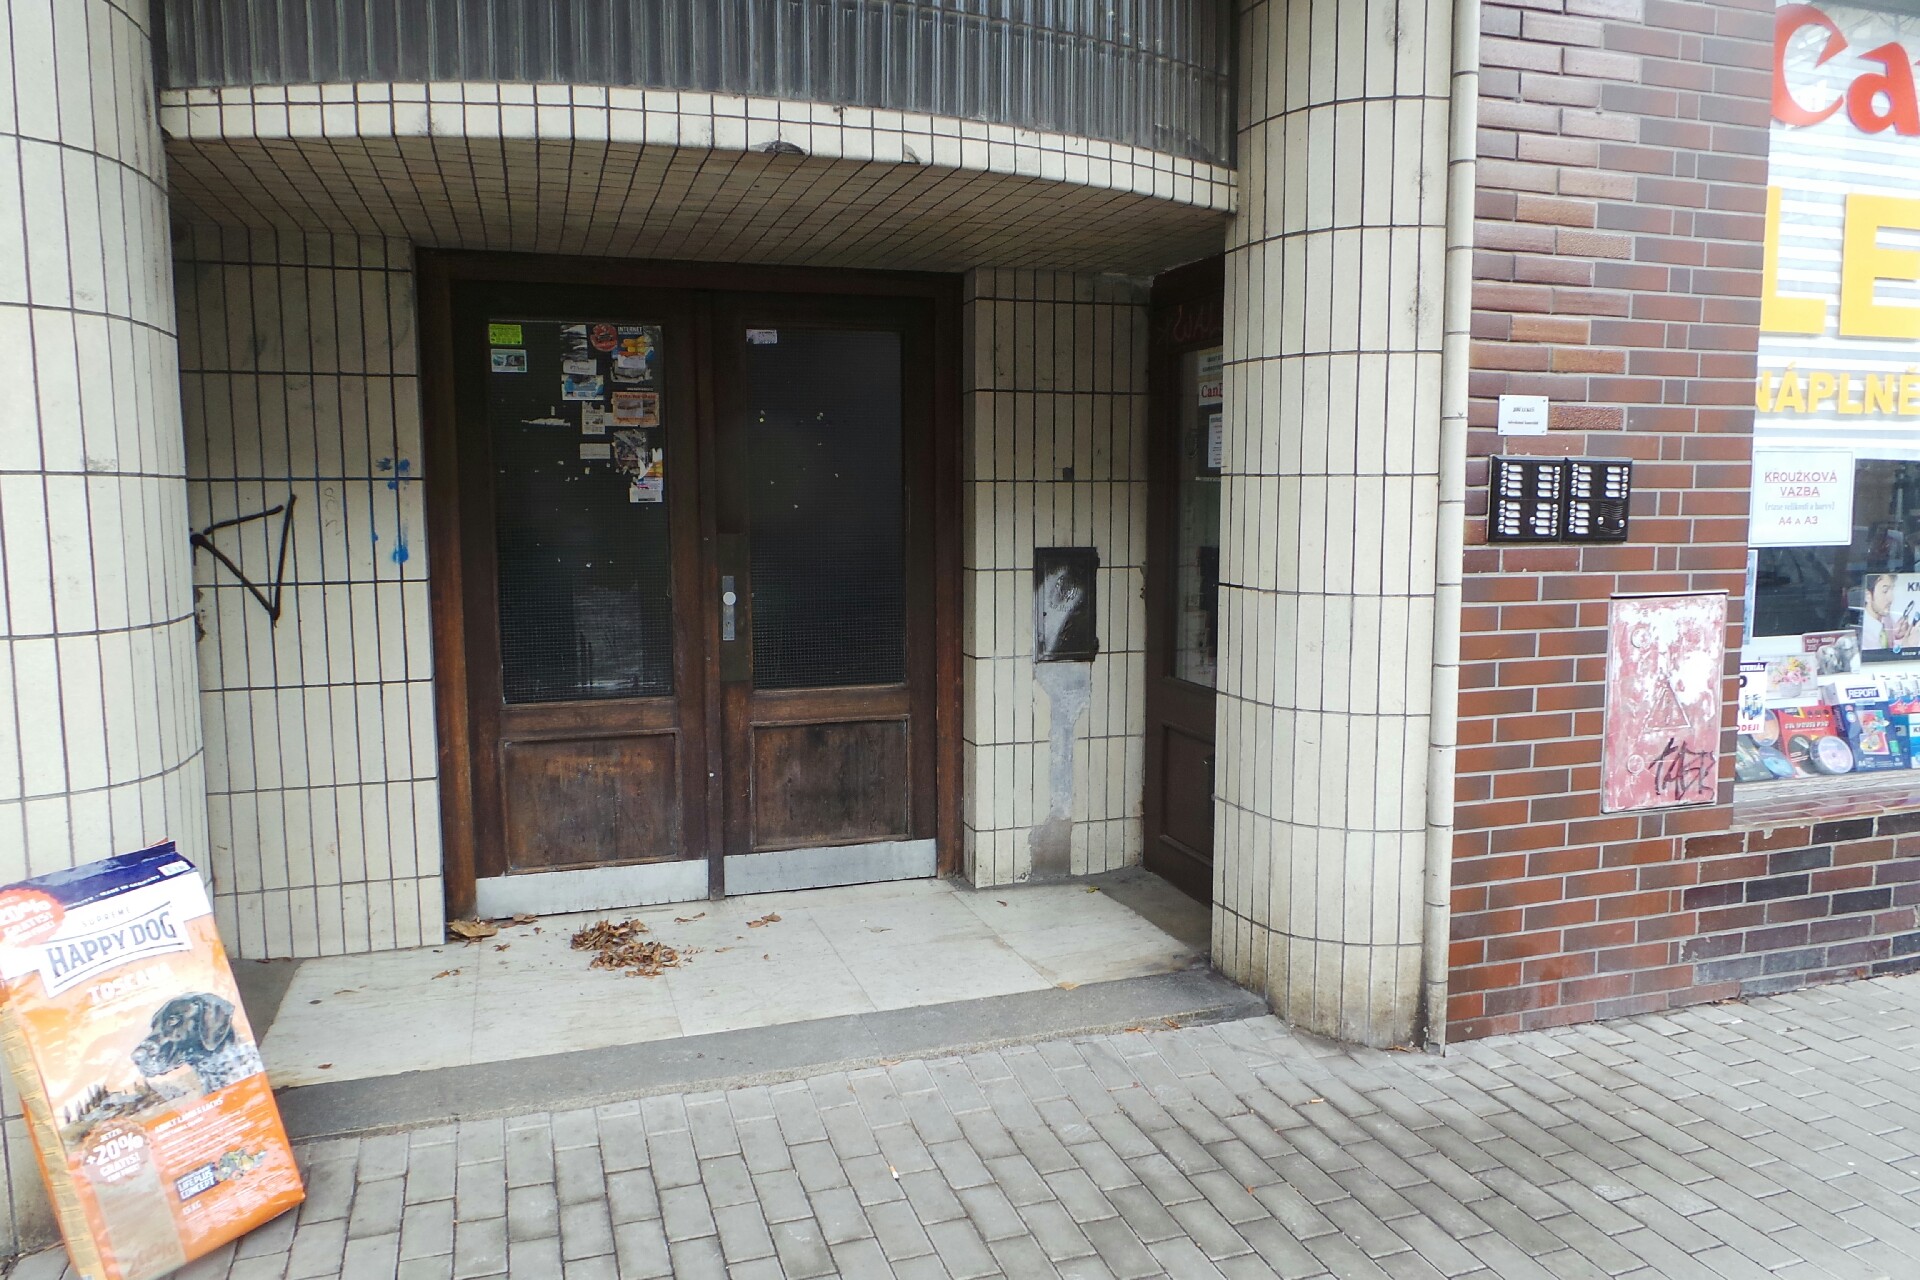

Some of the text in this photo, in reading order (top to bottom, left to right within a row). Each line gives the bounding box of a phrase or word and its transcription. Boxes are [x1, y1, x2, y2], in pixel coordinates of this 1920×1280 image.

[1771, 3, 1920, 136] Ca
[1780, 486, 1820, 497] VAZBA
[1847, 687, 1879, 699] REPORT
[46, 929, 125, 978] HAPPY
[129, 911, 177, 945] DOG
[86, 1132, 144, 1166] +20%
